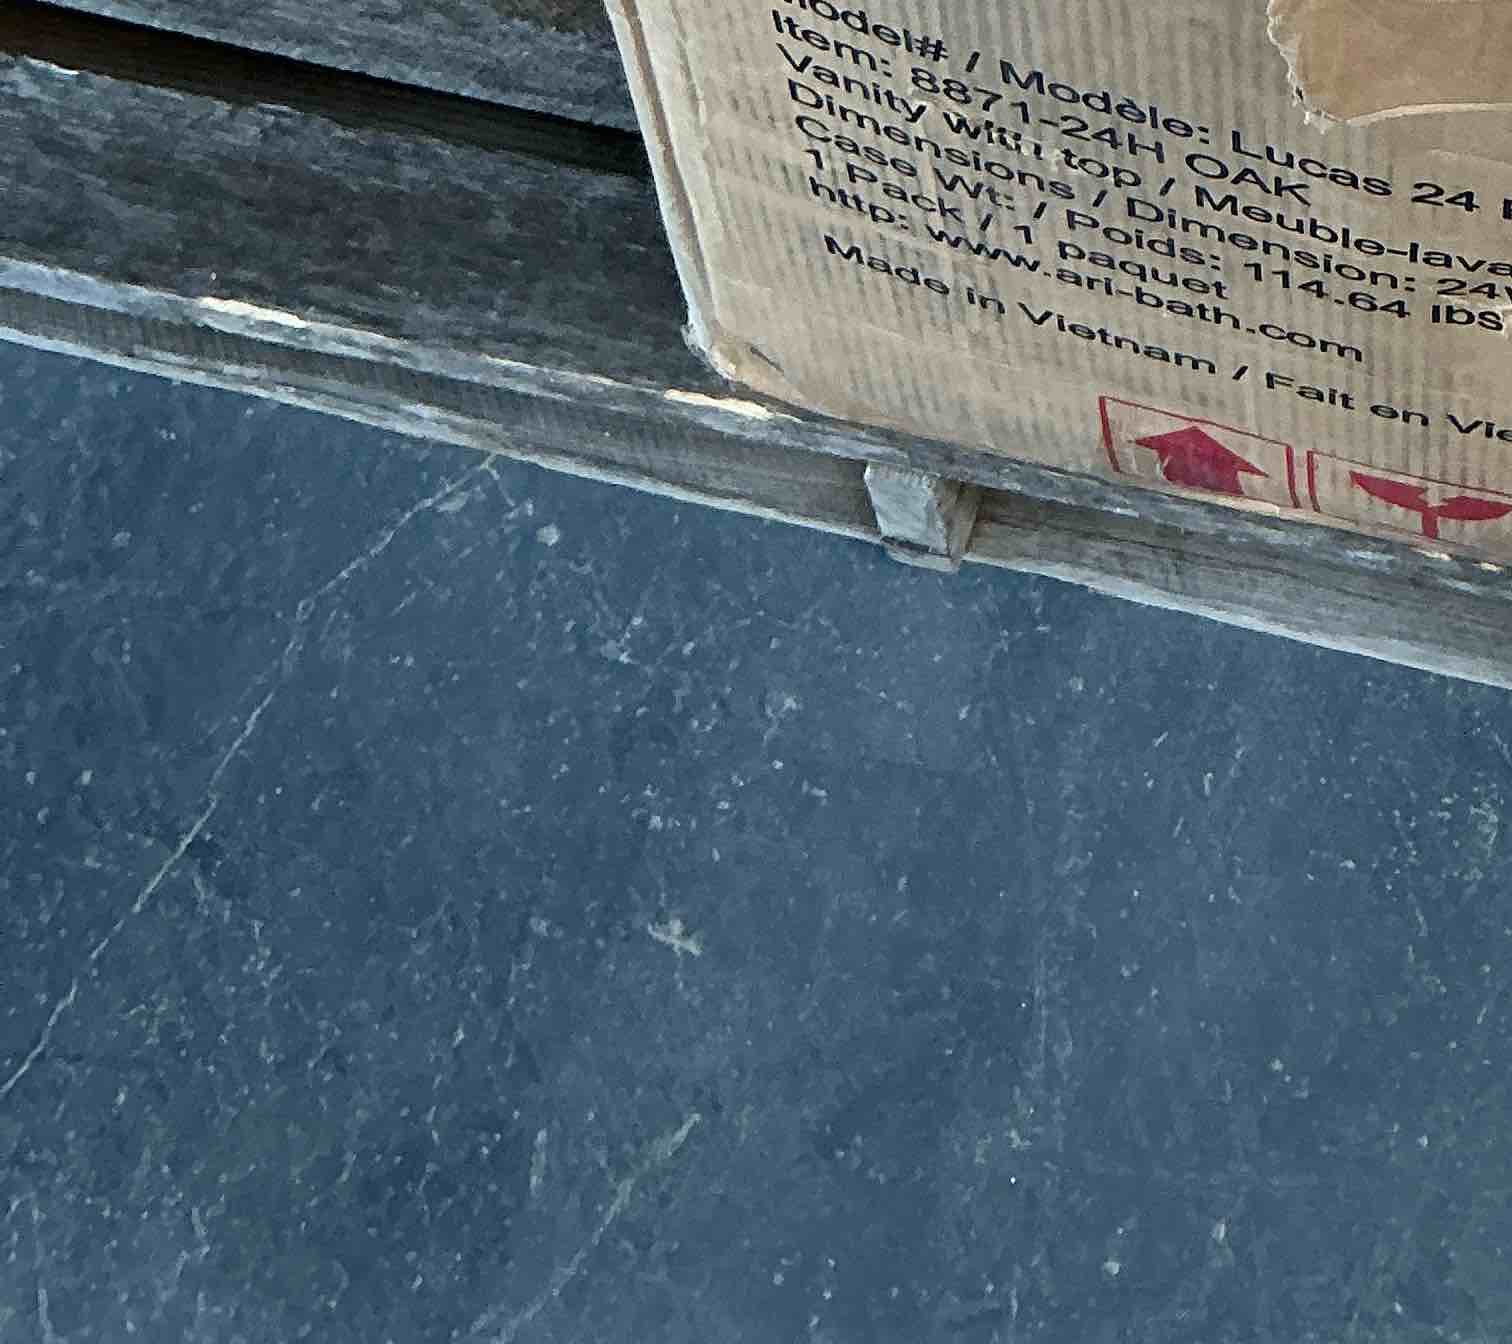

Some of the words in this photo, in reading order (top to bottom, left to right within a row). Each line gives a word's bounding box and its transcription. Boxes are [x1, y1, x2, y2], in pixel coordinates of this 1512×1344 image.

[769, 8, 894, 78] Item:
[910, 66, 1165, 164] 8871-24H
[1184, 152, 1312, 208] OAK
[775, 42, 927, 124] Vanity
[1060, 147, 1143, 189] top
[1159, 176, 1175, 198] /
[788, 76, 1075, 202] Dimensions
[1091, 188, 1107, 210] /
[1126, 195, 1417, 293] Dimension:
[964, 51, 981, 74] /
[999, 59, 1211, 146] Modèle:
[1230, 129, 1393, 198] Lucas
[1411, 183, 1481, 213] 24
[794, 113, 918, 179] Case
[932, 165, 1016, 213] Wt:
[1032, 200, 1048, 220] /
[1066, 208, 1223, 271] Poids:
[1243, 261, 1412, 320] 114.64
[1431, 302, 1506, 334] lbs
[805, 148, 826, 170] 1
[847, 163, 961, 223] Pack
[1014, 224, 1033, 245] 1
[1058, 239, 1229, 301] paquet
[808, 176, 909, 231] http:
[926, 223, 1365, 365] www.ari-bath.com
[822, 232, 950, 296] Made
[965, 285, 1006, 317] in
[1016, 300, 1217, 377] Vietnam
[1264, 370, 1357, 412] Fait
[1369, 400, 1430, 427] en
